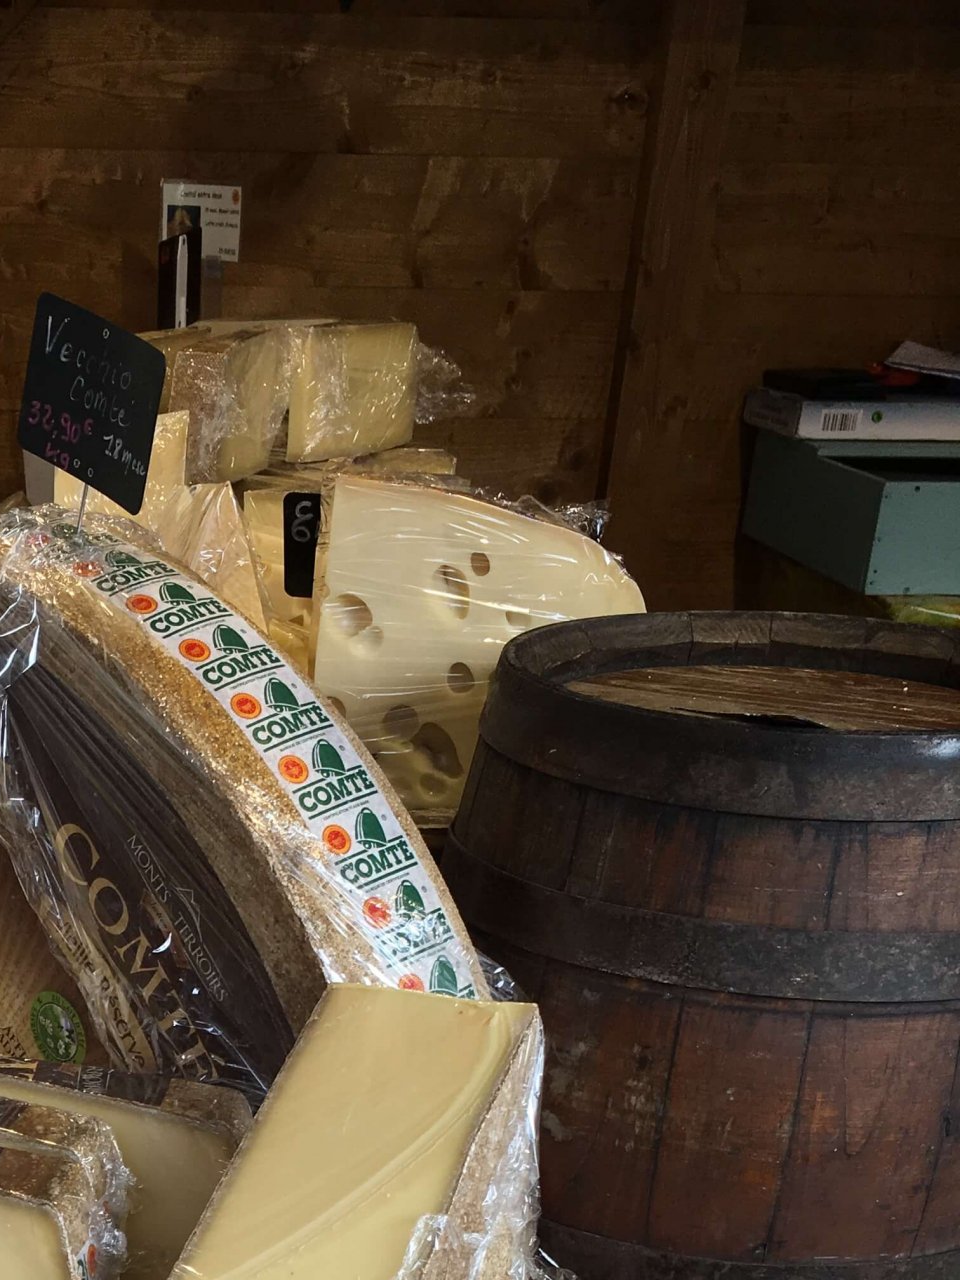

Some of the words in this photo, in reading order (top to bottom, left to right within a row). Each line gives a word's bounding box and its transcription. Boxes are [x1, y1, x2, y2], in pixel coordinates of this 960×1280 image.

[45, 315, 132, 390] Vecchio
[127, 834, 171, 902] MONTS
[173, 911, 229, 1002] TERROIRS
